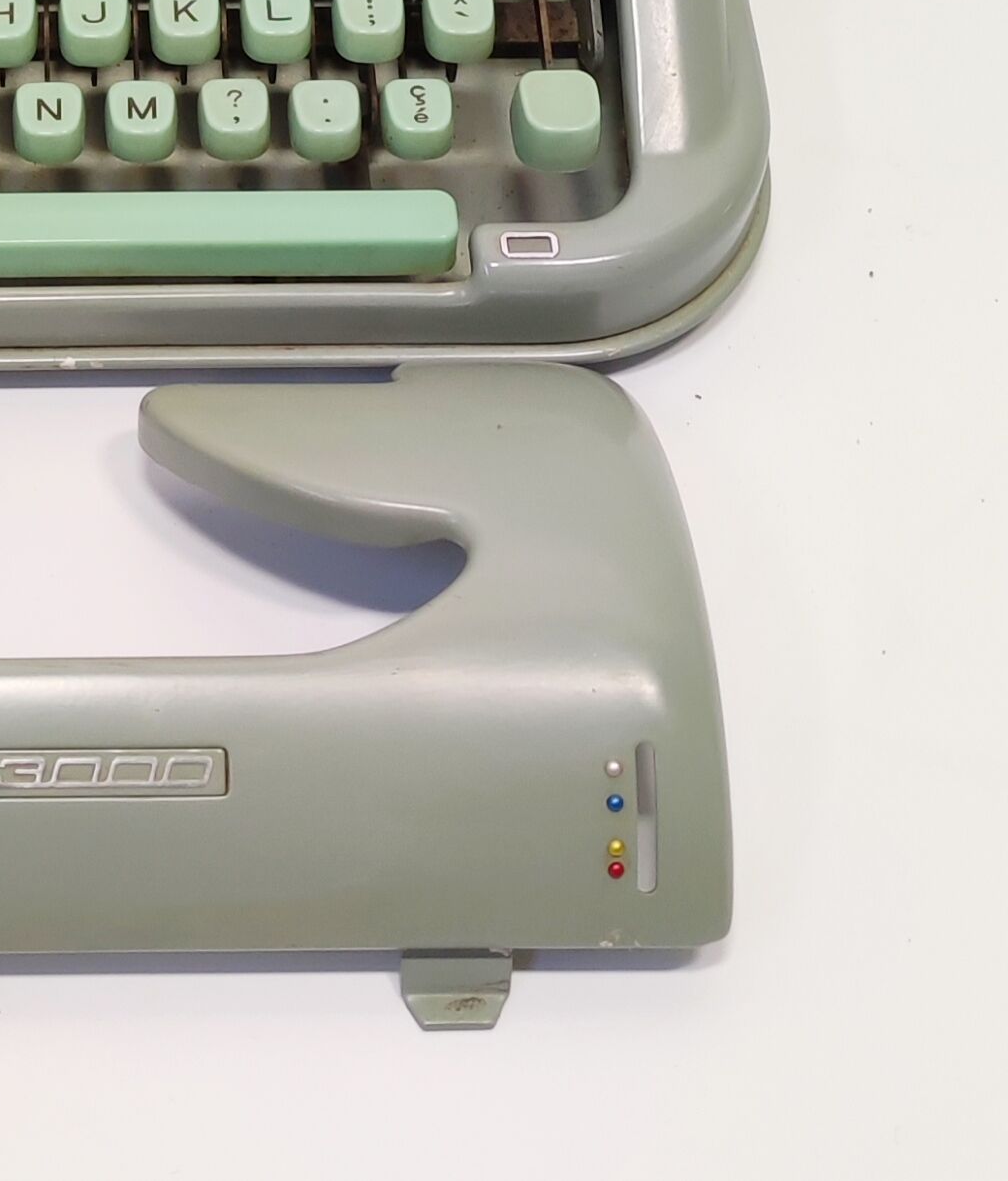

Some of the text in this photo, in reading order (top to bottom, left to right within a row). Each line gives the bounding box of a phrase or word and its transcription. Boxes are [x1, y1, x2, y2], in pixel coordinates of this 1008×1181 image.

[81, 1, 107, 24] J
[173, 0, 199, 23] K
[36, 98, 62, 121] N
[127, 96, 158, 120] M
